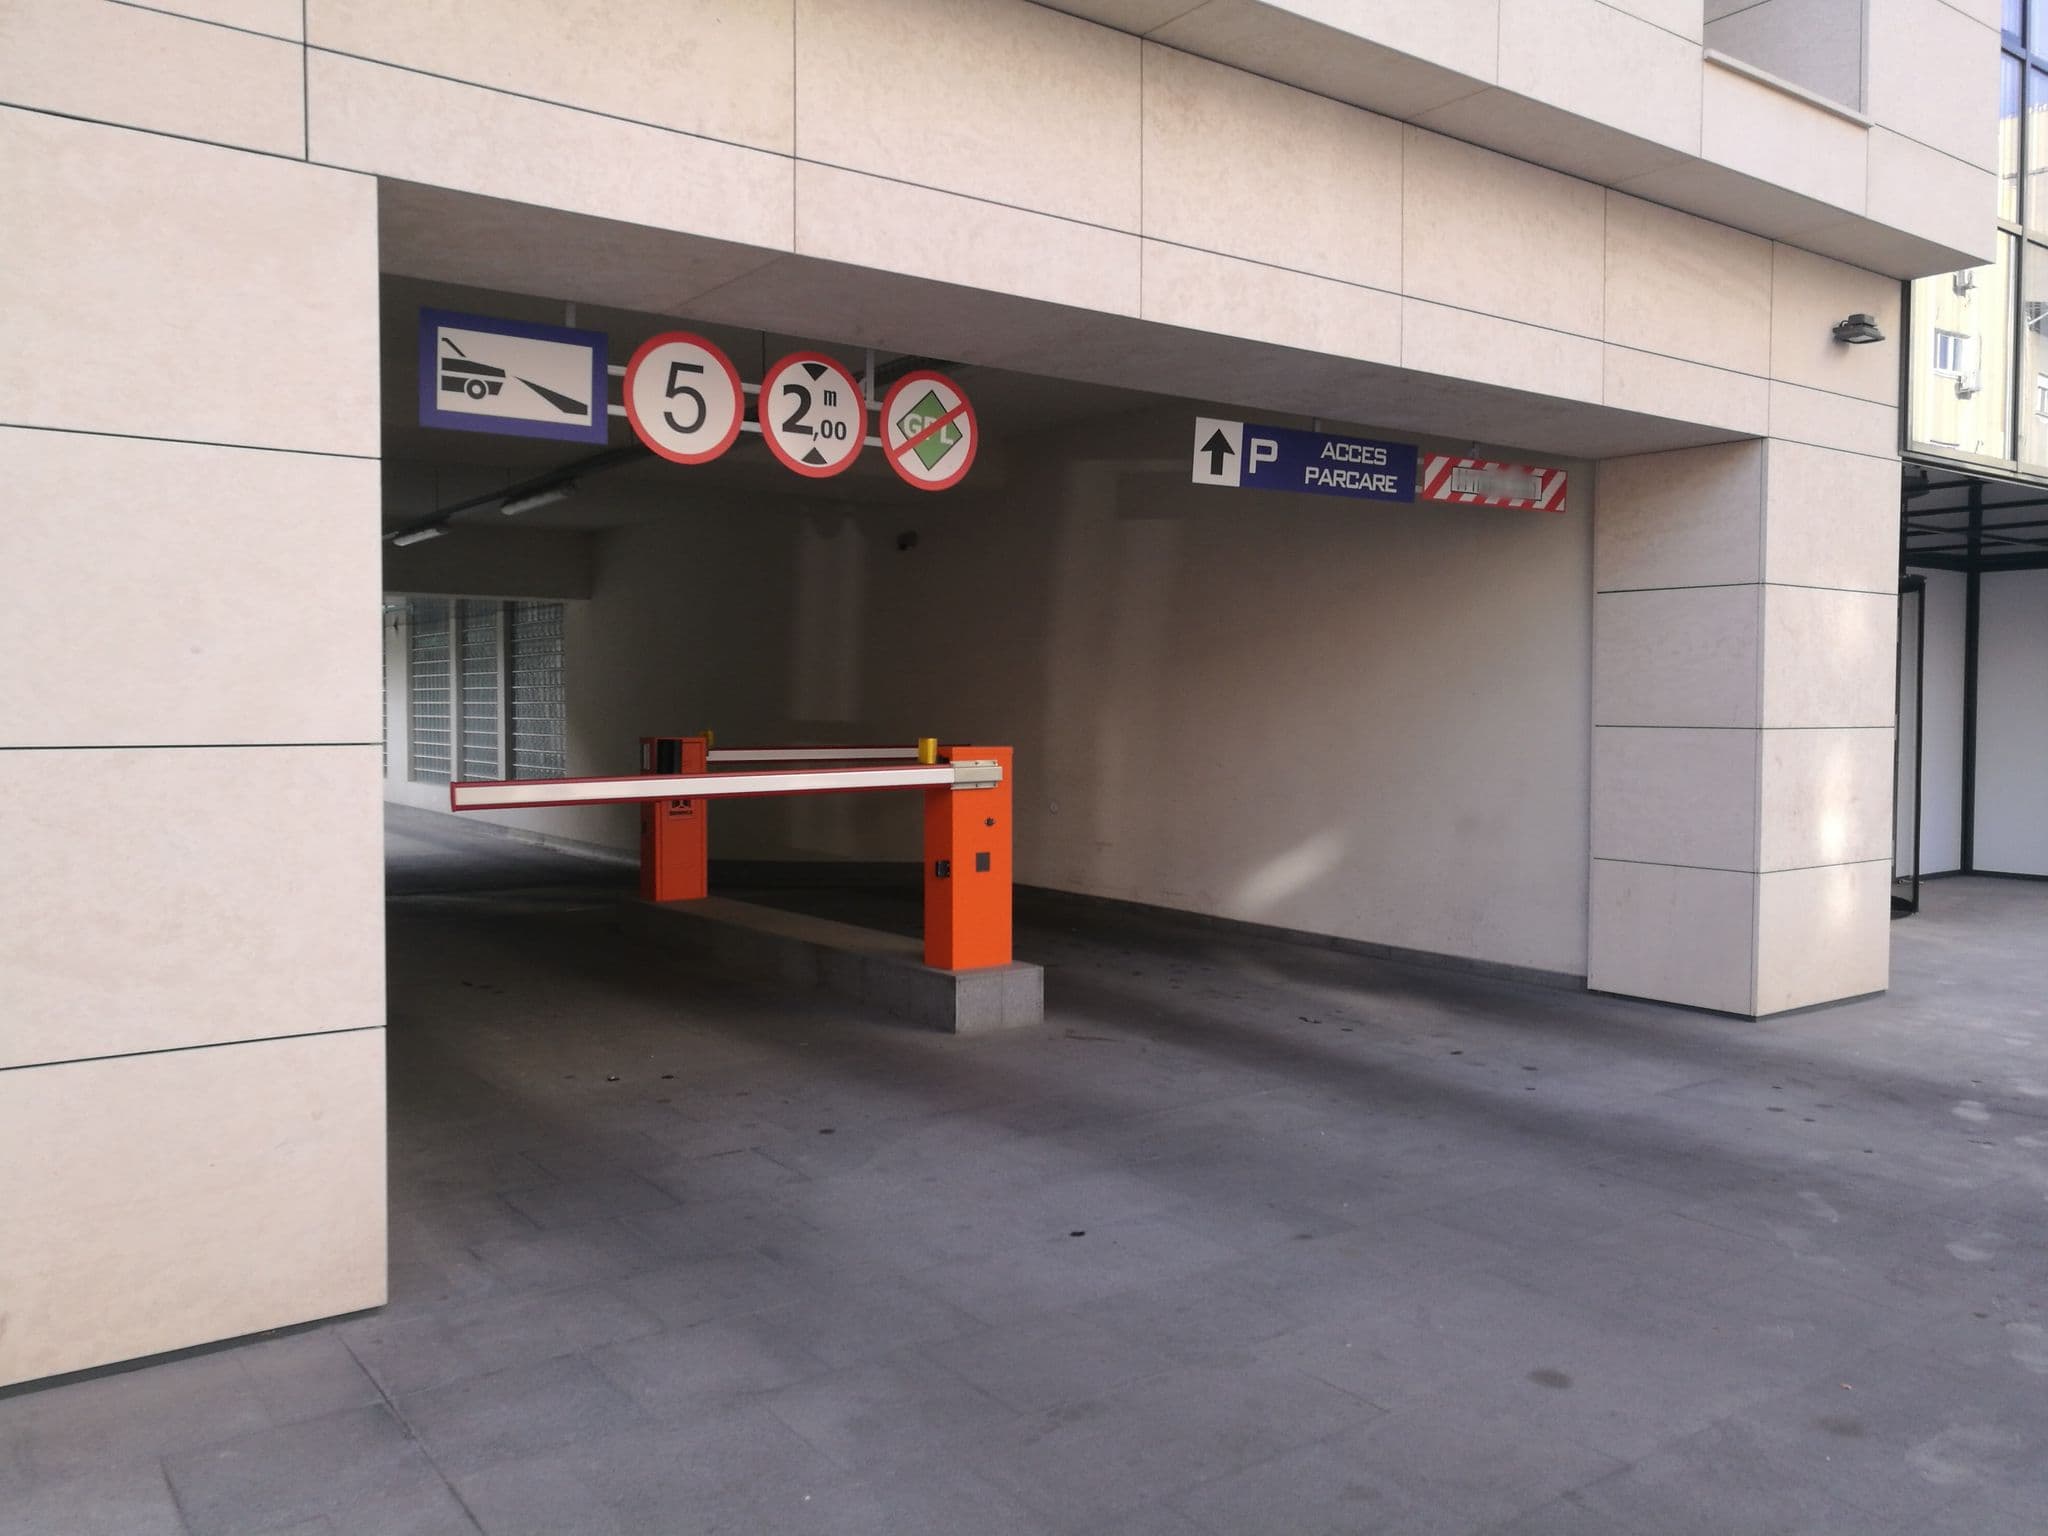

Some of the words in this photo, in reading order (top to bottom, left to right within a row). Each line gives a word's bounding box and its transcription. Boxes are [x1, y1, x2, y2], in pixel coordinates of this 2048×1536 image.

[663, 361, 707, 434] 5
[1249, 438, 1278, 474] P
[1320, 442, 1387, 465] ACCES
[1305, 466, 1397, 493] PARCARE
